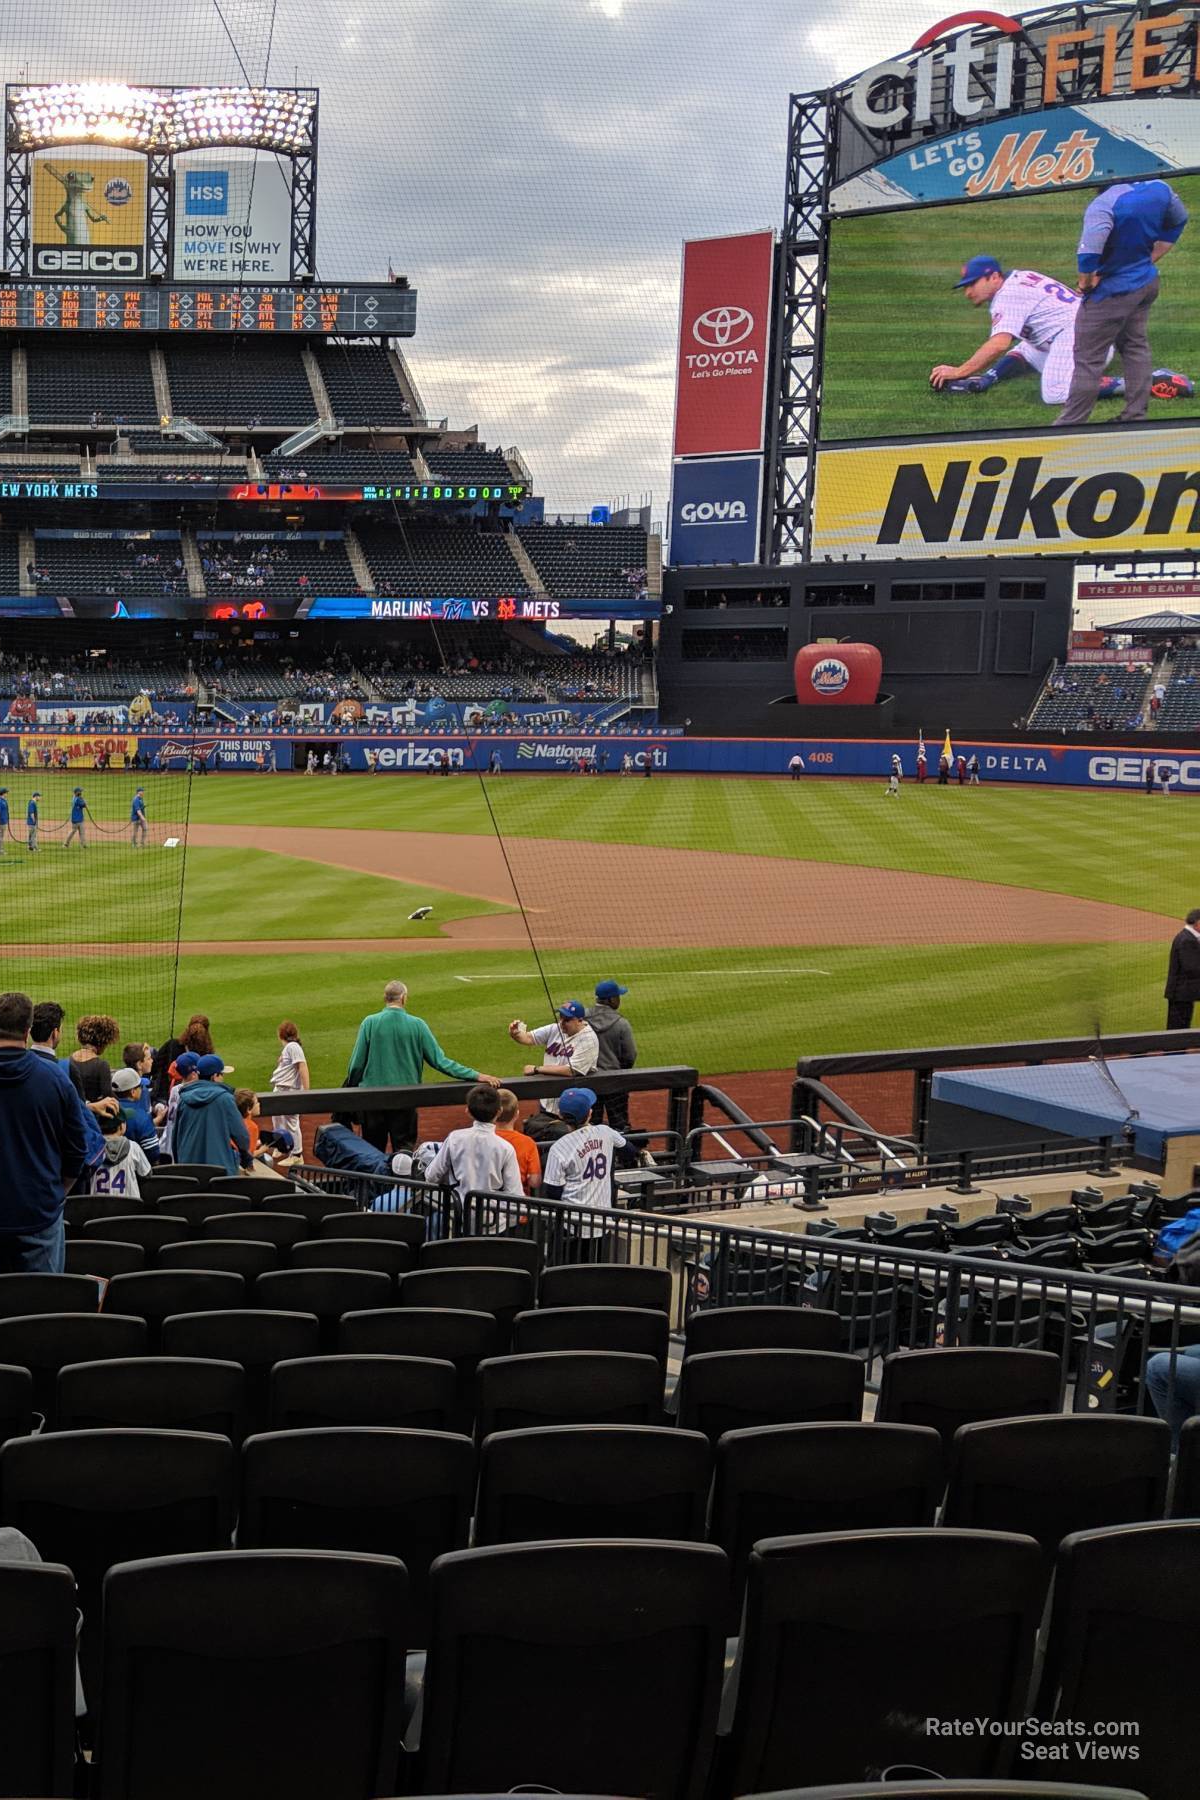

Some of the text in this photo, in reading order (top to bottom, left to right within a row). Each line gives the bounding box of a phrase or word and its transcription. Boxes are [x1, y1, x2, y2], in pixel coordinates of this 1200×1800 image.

[851, 13, 1200, 129] citi FIE
[908, 132, 982, 171] LET'S
[949, 129, 1100, 196] GO Mets
[190, 186, 224, 200] HSS
[184, 225, 252, 237] HOW YOU
[184, 242, 281, 254] MOVE IS WHY
[37, 250, 138, 271] GEICO
[184, 259, 274, 272] WE'RE HERE.
[62, 292, 79, 300] TEX
[62, 310, 79, 318] DET
[124, 311, 140, 319] CLE
[323, 322, 334, 330] SF
[686, 349, 759, 369] TOYOTA
[692, 366, 752, 378] Let's Go Places
[26, 484, 58, 497] YORK
[64, 484, 98, 498] METS
[458, 487, 464, 498] S
[876, 456, 1200, 545] Nikon
[681, 500, 746, 522] GOYA
[1088, 586, 1116, 594] THE
[1120, 585, 1142, 593] JIM
[371, 601, 560, 617] MARLINS VS METS
[67, 738, 129, 760] MASON
[220, 740, 271, 750] THIS BUD'S
[535, 743, 597, 759] National
[220, 752, 238, 762] FOR
[364, 742, 464, 766] verizon
[635, 751, 667, 766] cti
[808, 752, 834, 763] 408
[986, 756, 1047, 772] DELTA
[1088, 757, 1200, 785] GEICO
[545, 1042, 575, 1058] Mets
[583, 1153, 607, 1181] 48
[96, 1168, 126, 1193] 24
